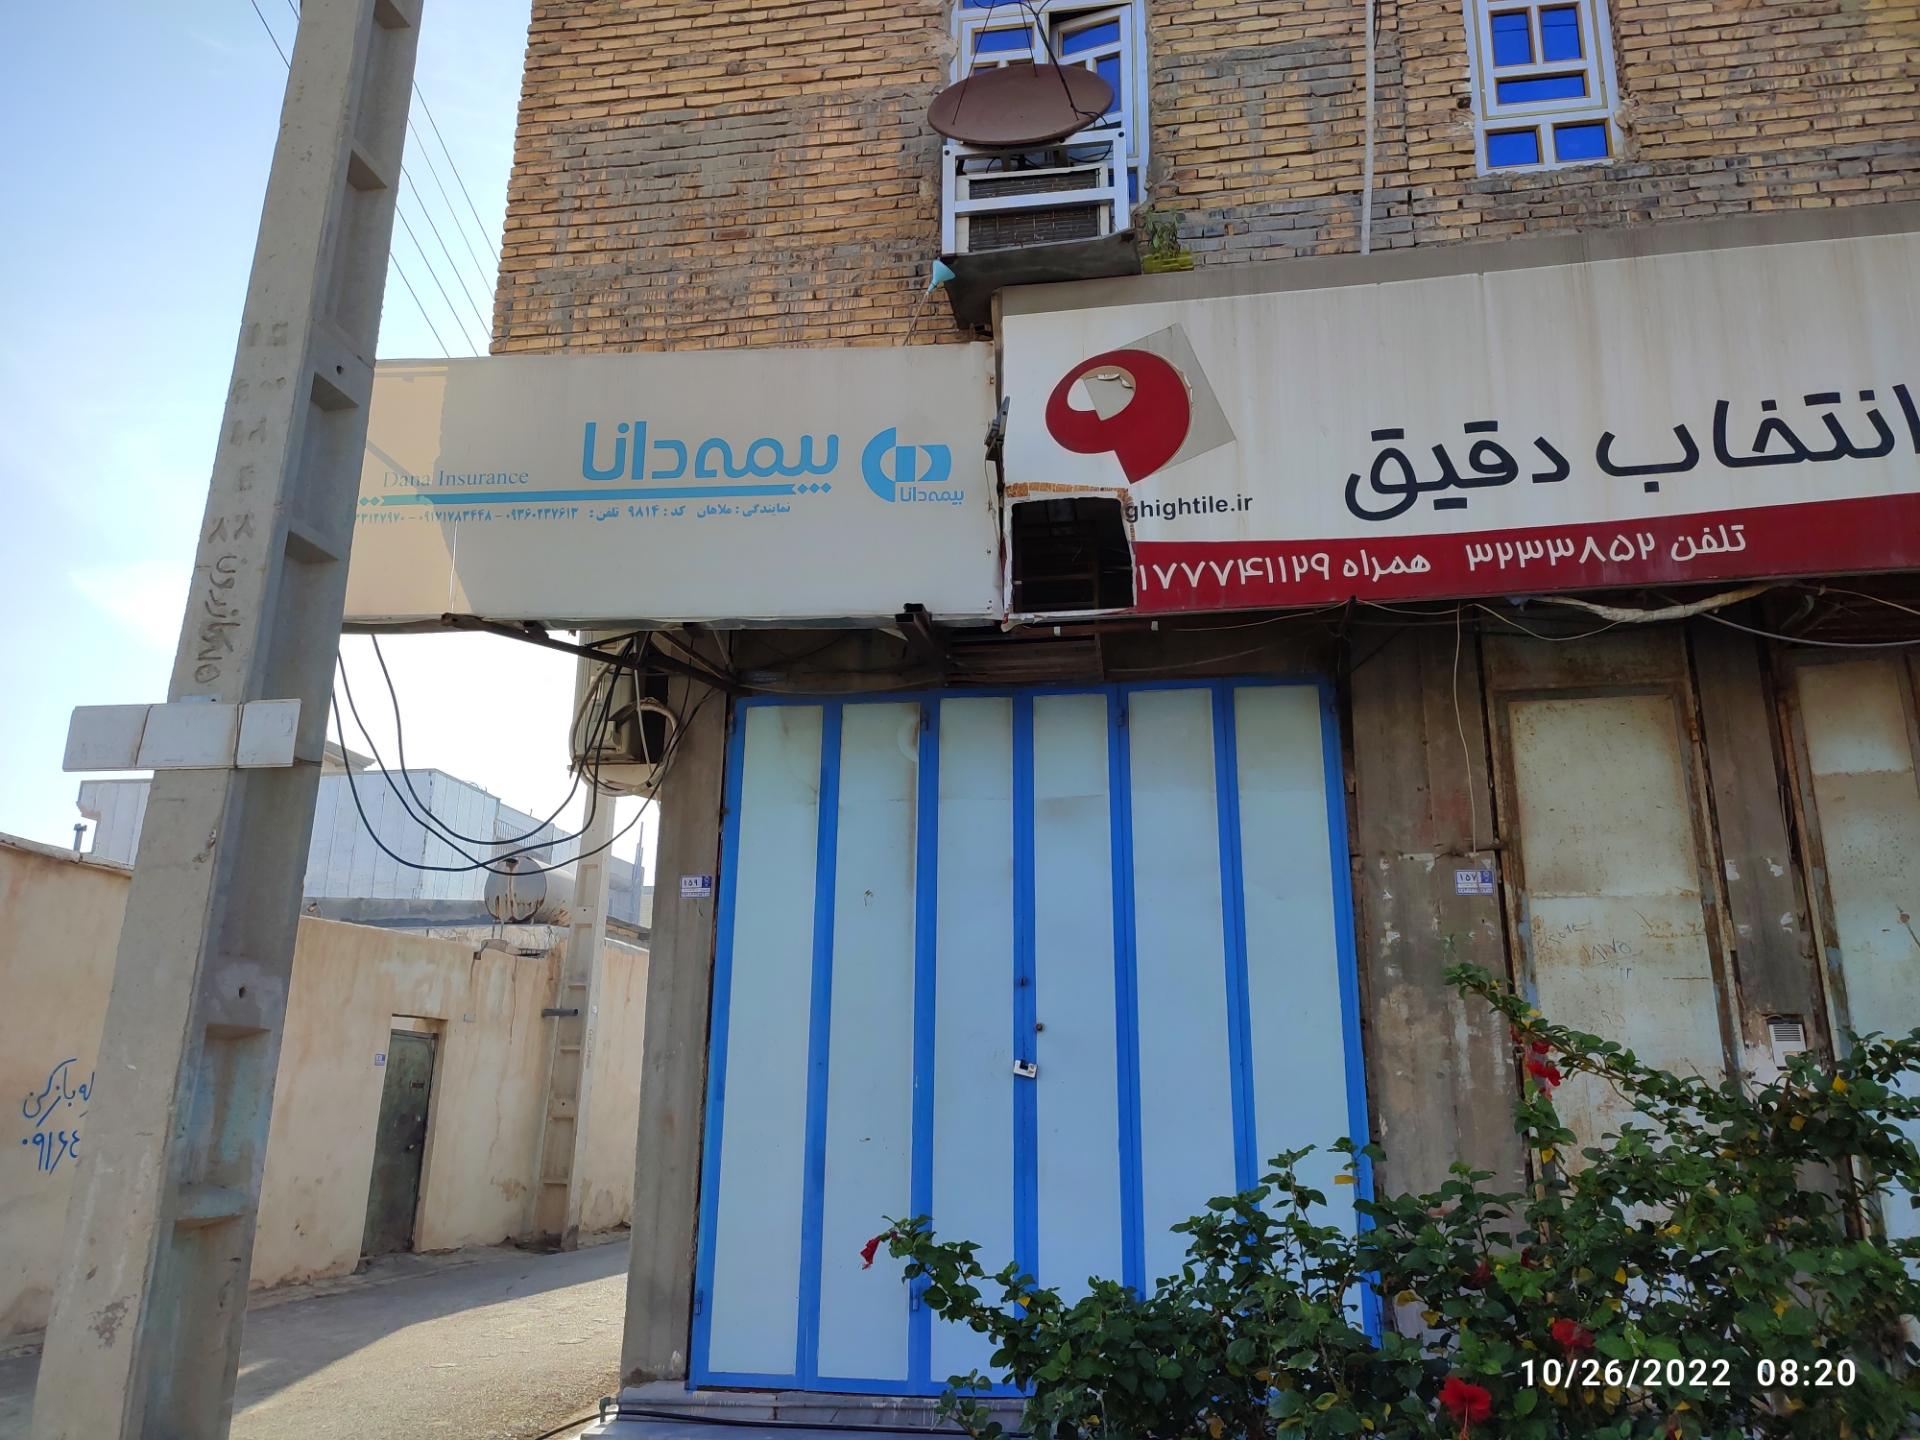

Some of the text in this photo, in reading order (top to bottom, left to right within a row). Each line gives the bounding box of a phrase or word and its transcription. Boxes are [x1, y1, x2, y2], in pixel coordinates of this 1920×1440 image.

[582, 420, 839, 494] بیمه دانا
[1345, 384, 1920, 521] انتخاب دقیق
[383, 470, 529, 487] Dana Insurance
[900, 486, 964, 505] بیمه دانا
[628, 504, 660, 518] ۹۸۱۴
[1465, 532, 1656, 572] ۳۲۳۳۸۵۲
[1671, 524, 1746, 562] تلفن
[1343, 549, 1432, 582] همراه
